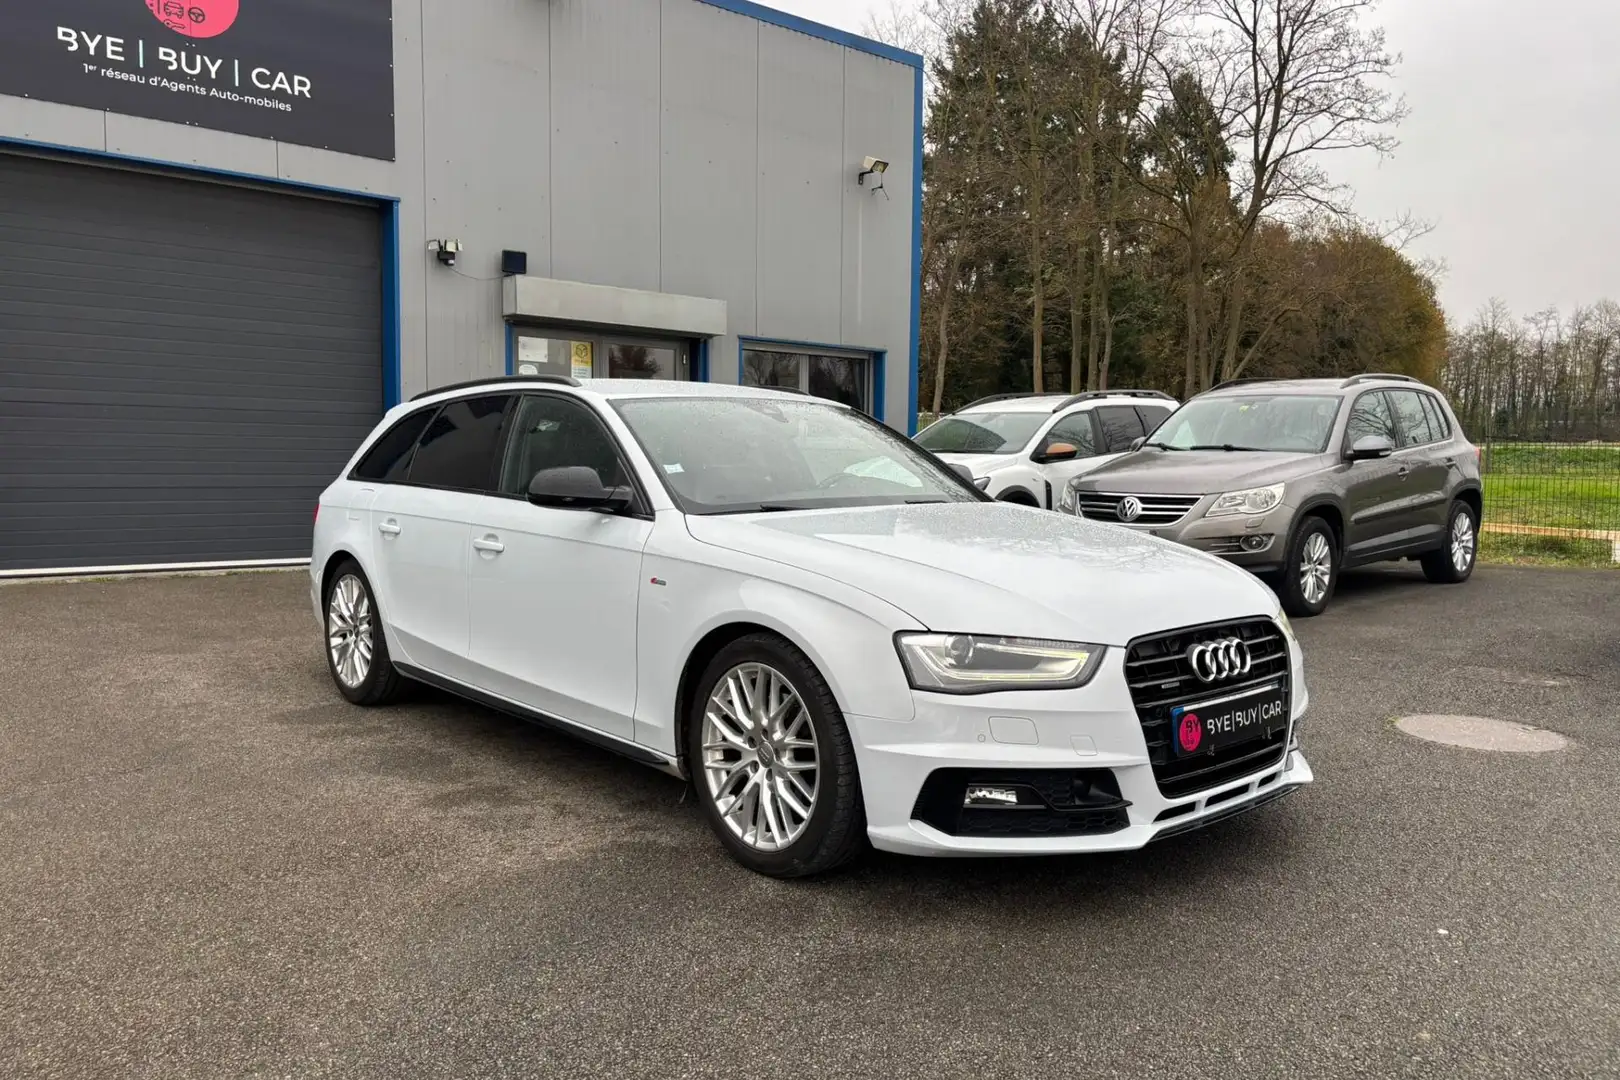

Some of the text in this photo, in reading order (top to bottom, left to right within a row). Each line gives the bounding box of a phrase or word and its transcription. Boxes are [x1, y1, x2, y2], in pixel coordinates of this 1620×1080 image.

[57, 26, 311, 98] BYE BUY CAR
[101, 68, 145, 84] réseau
[149, 76, 207, 95] d'Agents
[209, 88, 292, 112] Auto-mobiles
[1207, 700, 1282, 735] BYE BUY CAR
